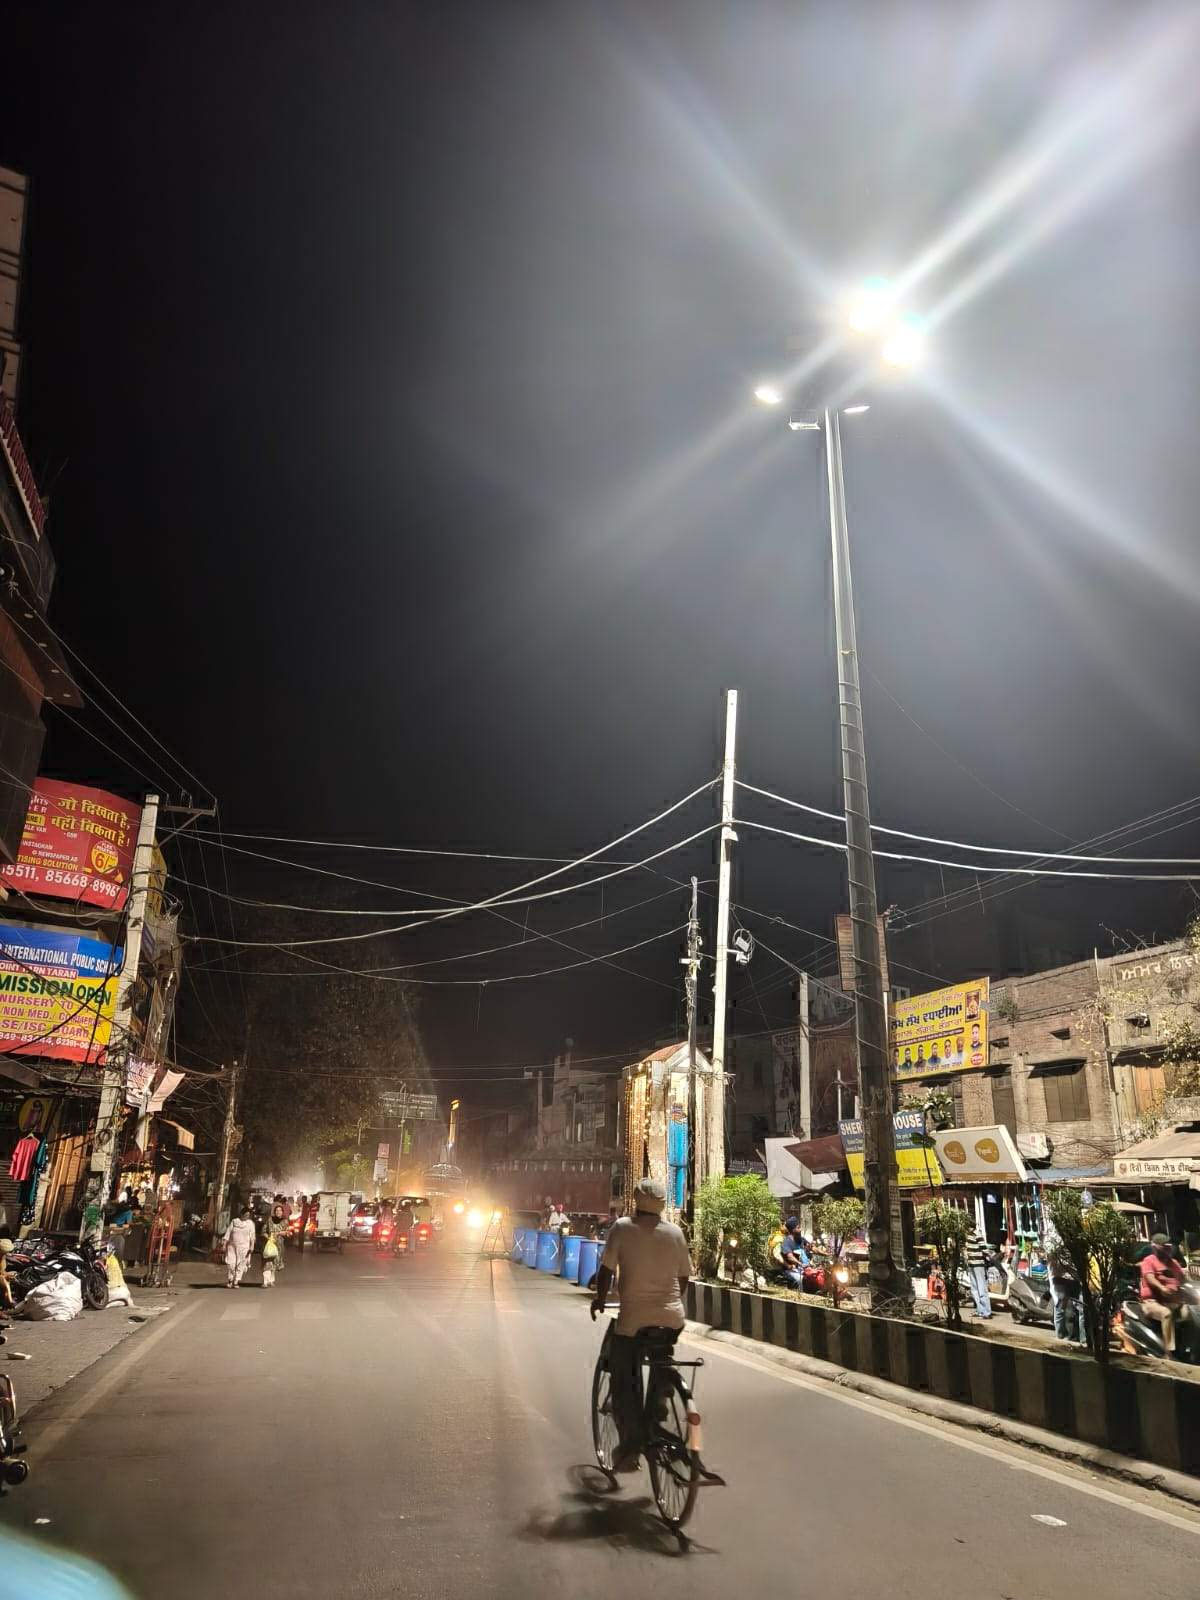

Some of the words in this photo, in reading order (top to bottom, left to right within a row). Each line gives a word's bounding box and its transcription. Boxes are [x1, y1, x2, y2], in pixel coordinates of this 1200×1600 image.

[43, 859, 78, 872] SOLUTION
[5, 945, 68, 965] INTERNATIONAL
[70, 953, 95, 972] PUBLIC
[47, 968, 77, 979] TARAN
[77, 984, 111, 1006] OPEN
[840, 1121, 864, 1135] SHER
